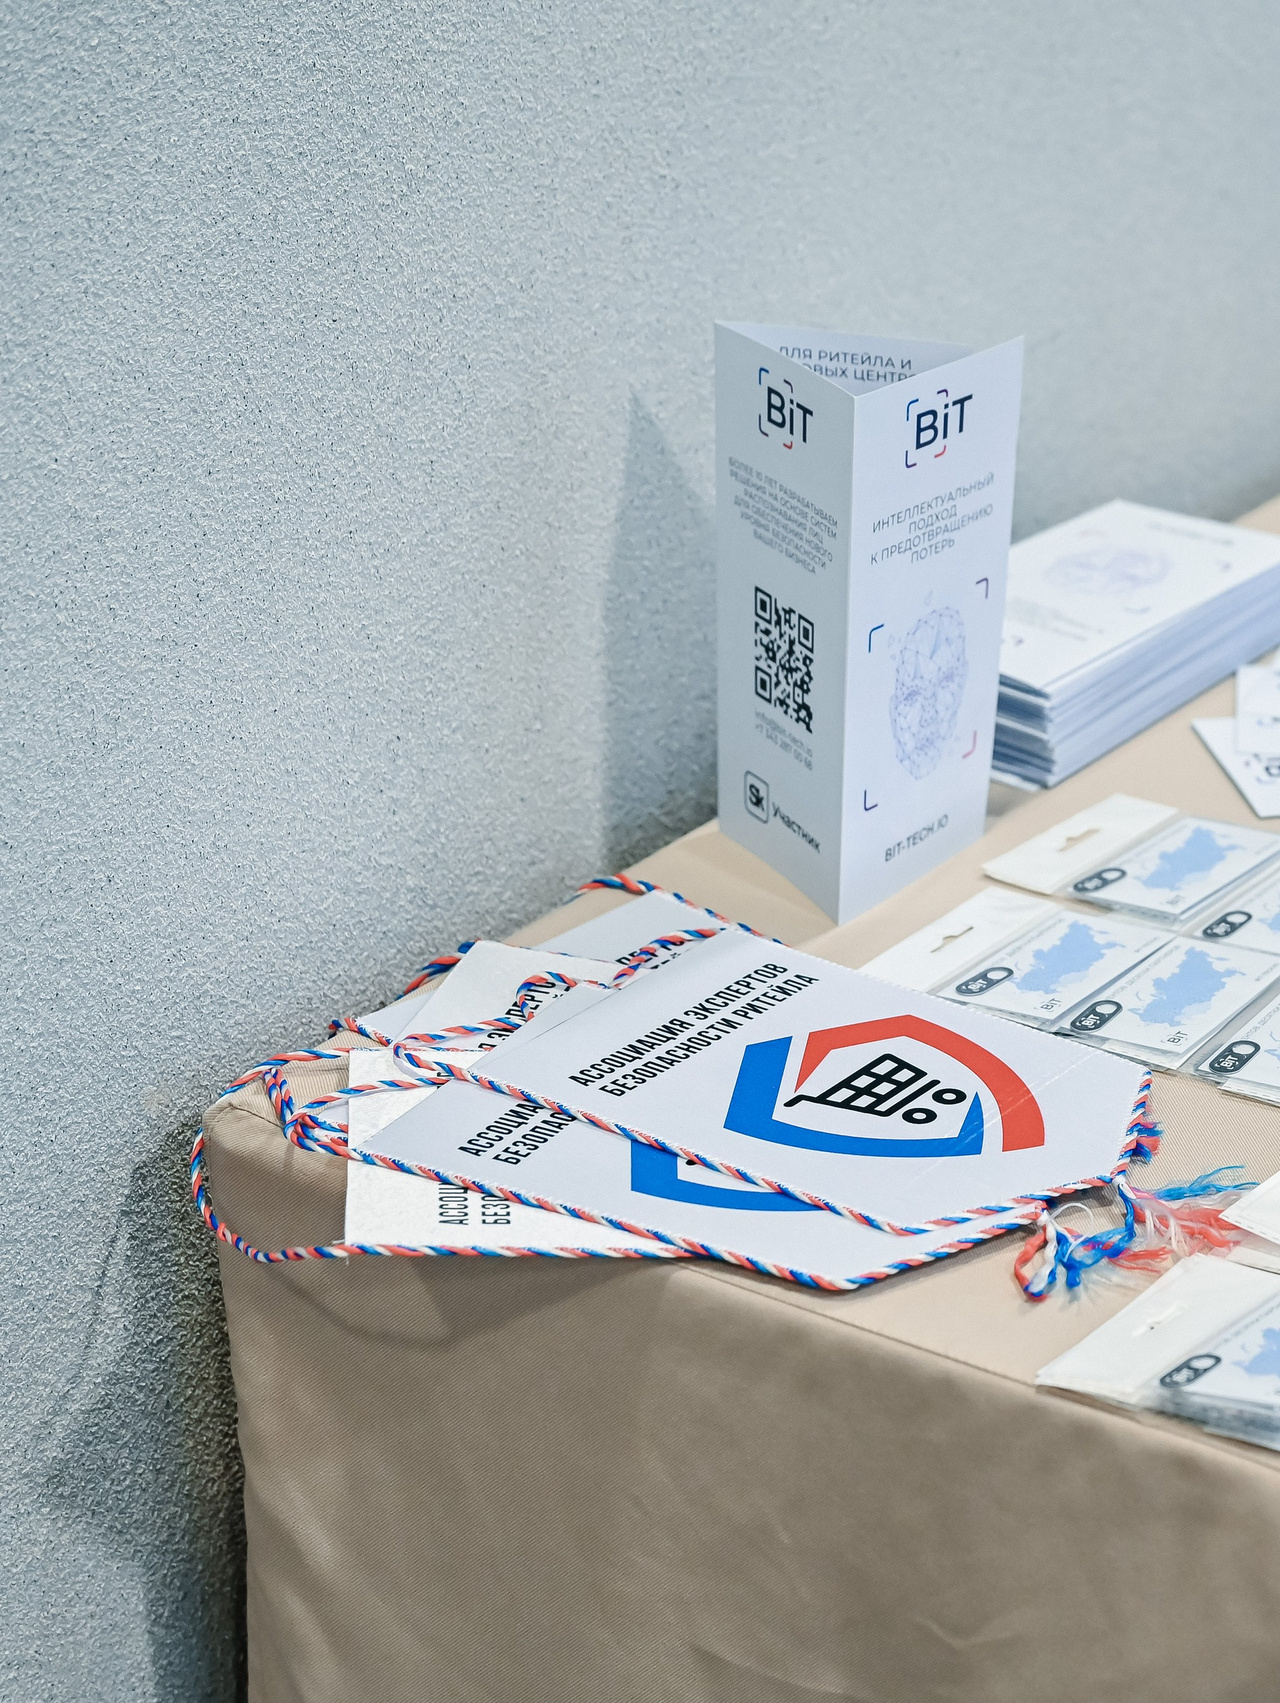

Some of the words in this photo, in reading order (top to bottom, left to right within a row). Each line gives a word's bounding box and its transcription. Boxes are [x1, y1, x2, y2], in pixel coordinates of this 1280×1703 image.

[818, 349, 896, 369] РИТЕЙЛА
[900, 359, 912, 370] И
[872, 472, 994, 534] ИНТЕЛЛЕКТУАЛЬНЫЙ
[908, 504, 957, 534] ПОДХОД
[870, 552, 878, 565] К
[881, 503, 994, 560] ПРЕДОТВРАЩЕНИЮ
[911, 537, 956, 563] ПОТЕРЬ
[772, 802, 820, 854] Участник
[884, 814, 949, 863] BIT-TECH.IO
[568, 1018, 695, 1087] АССОЦИАЦИЯ
[683, 963, 788, 1021] ЭКСПЕРТОВ
[598, 1017, 743, 1097] БЕЗОПАСНОСТИ
[731, 973, 820, 1020] РИТЕЙЛА
